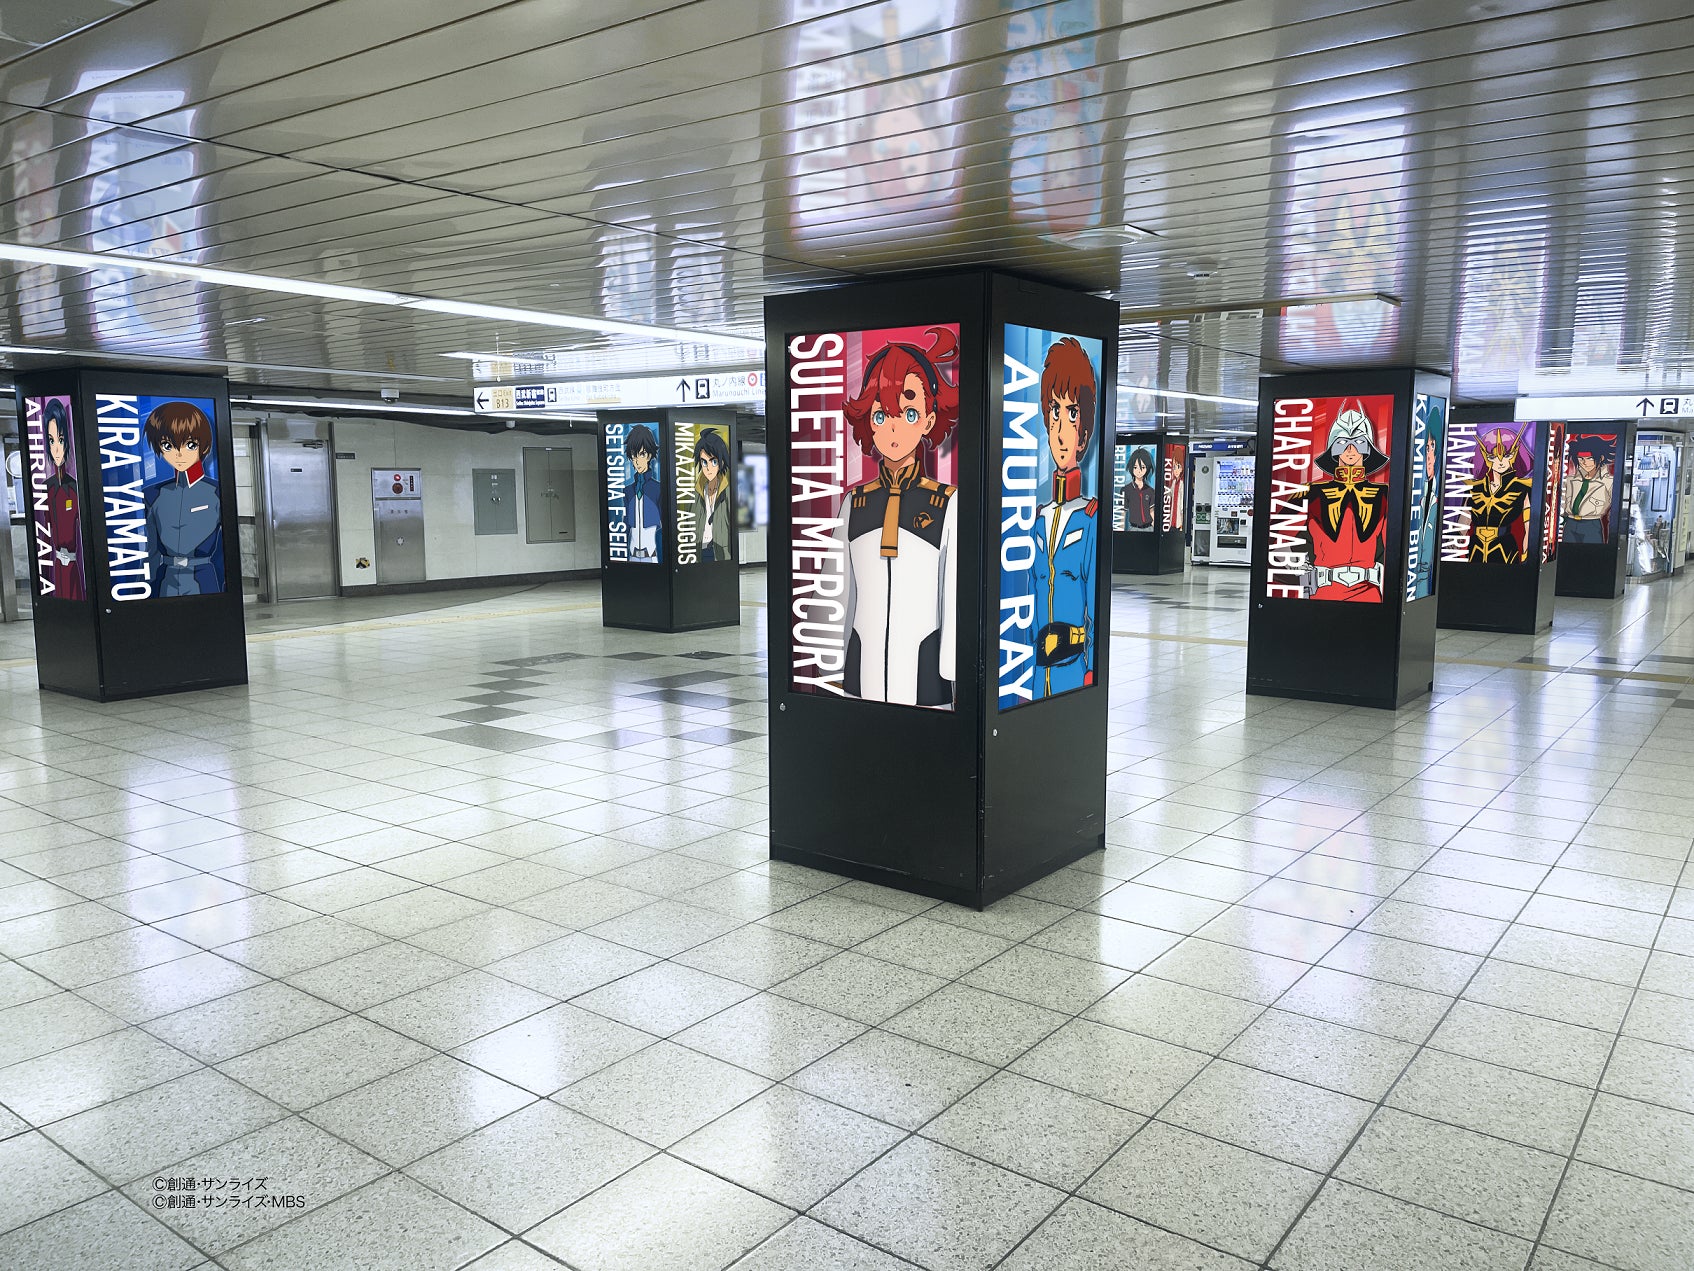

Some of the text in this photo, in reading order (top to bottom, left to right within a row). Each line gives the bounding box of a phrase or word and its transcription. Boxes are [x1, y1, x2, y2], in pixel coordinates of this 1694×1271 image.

[24, 398, 56, 596] ATHRUN ZALA
[95, 394, 152, 602] KIRA YAMATO
[605, 423, 628, 562] SETSUNA F SEIEI
[674, 422, 698, 565] MIKAZUKI AUGUS
[789, 333, 846, 697] SULETTA MERCURY
[997, 353, 1040, 708] AMURO RAY
[1161, 457, 1173, 532] KIO ASUNO
[1266, 398, 1314, 599] CHAR AZNABLE
[1406, 393, 1428, 602] KAMILLE BIDAN
[1440, 423, 1478, 563] HAMAN KARN
